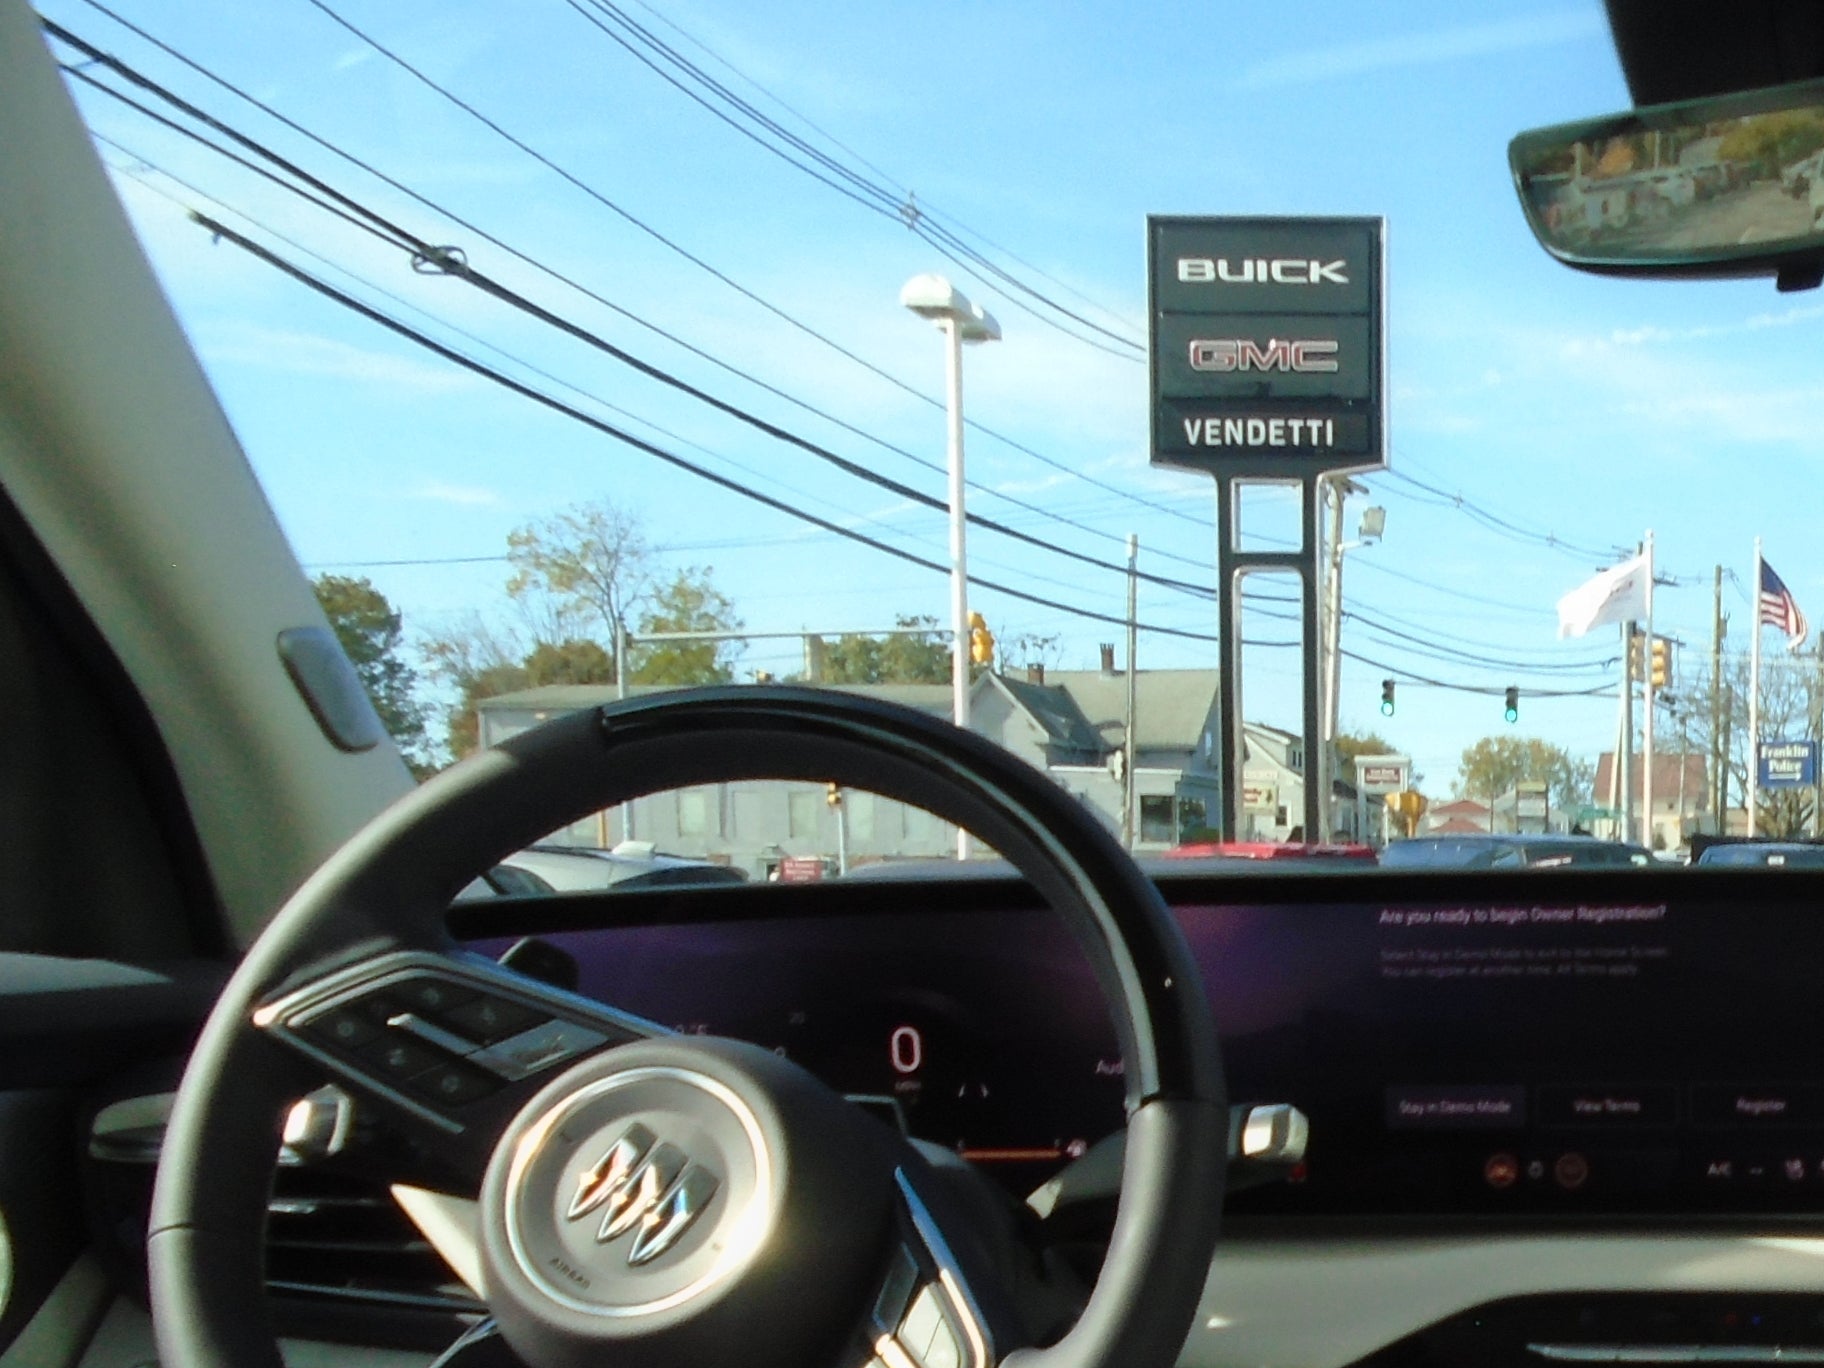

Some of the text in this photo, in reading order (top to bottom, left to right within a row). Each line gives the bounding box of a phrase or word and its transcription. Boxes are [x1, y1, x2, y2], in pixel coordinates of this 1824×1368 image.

[1177, 258, 1350, 284] BUICK
[1189, 338, 1339, 373] GMC
[1184, 417, 1334, 447] VENDETTI
[1760, 745, 1809, 759] Franklin
[1768, 759, 1802, 773] Police
[1379, 904, 1667, 926] Are you ready to begin Owner Registration?
[890, 1025, 922, 1074] 0
[1735, 1096, 1787, 1114] Register
